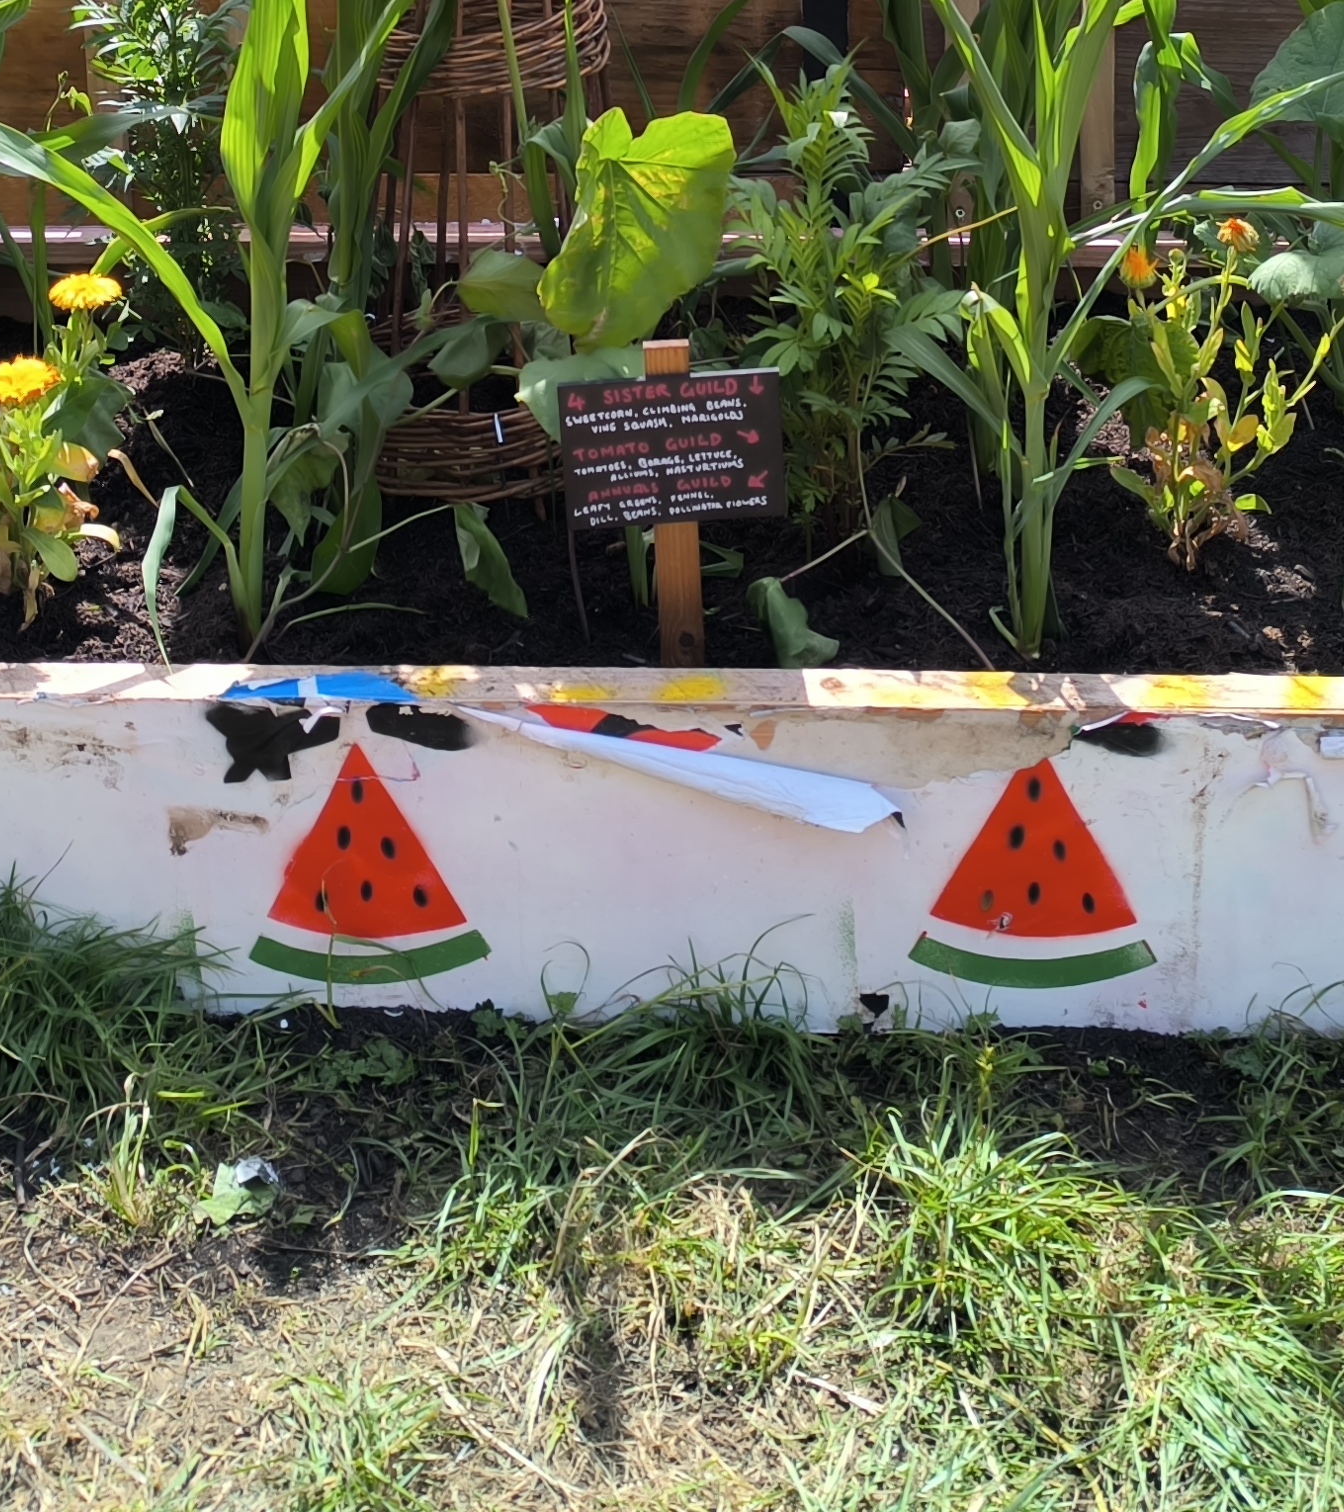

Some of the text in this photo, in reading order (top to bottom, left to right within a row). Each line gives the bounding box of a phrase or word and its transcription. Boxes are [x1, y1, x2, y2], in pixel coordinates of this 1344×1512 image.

[567, 377, 738, 411] 4 SISTER GUILD
[642, 402, 696, 416] CLIMBING
[681, 409, 744, 424] MARIGOLDS
[573, 432, 722, 462] TOMATO GUILD
[666, 457, 745, 476] NASTURTIUMS
[676, 475, 732, 491] GUILD
[573, 502, 611, 517] LEAFY
[726, 495, 768, 509] FLOWERS
